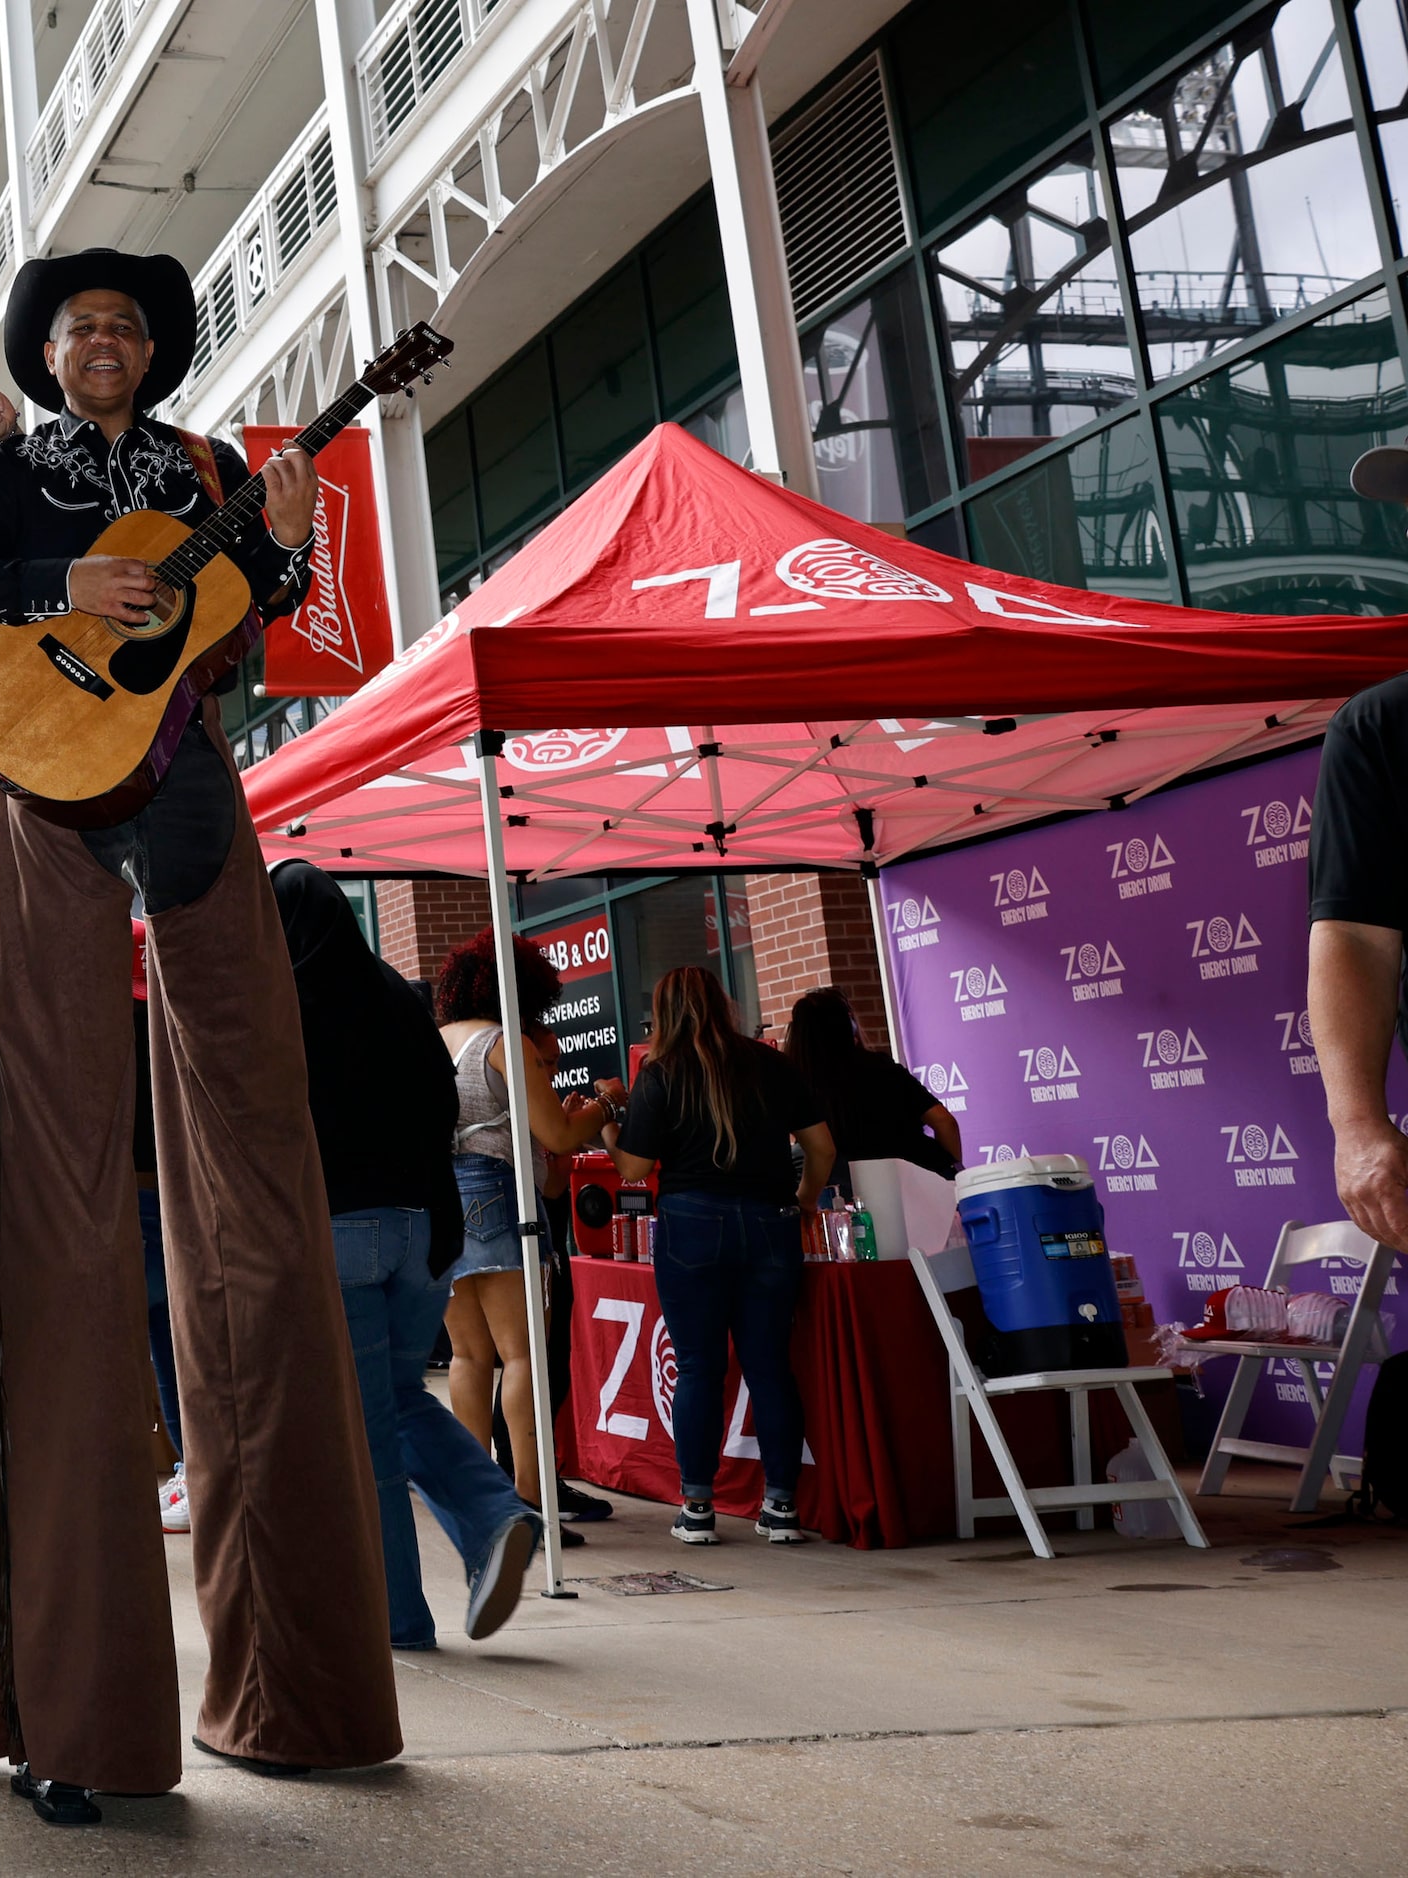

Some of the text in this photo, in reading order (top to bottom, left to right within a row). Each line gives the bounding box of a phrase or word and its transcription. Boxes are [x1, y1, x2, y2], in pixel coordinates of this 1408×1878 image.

[1255, 843, 1289, 868] ENERGY
[1118, 872, 1173, 900] ENERGY DRINK
[1001, 902, 1048, 926] ENERGY DRINK
[571, 943, 583, 968] &
[583, 927, 609, 963] GO
[897, 928, 939, 952] ENERGY DRINK
[1199, 953, 1258, 980] ENERGY DRINK
[1072, 978, 1123, 1002] ENERGY DRINK
[960, 999, 1006, 1022] ENERGY DRINK
[557, 1026, 617, 1054] NDWICHES
[1289, 1055, 1321, 1075] ENERG
[552, 1067, 590, 1089] NACKS
[1150, 1067, 1205, 1090] ENERGY DRINK
[1030, 1082, 1080, 1103] ENERGY DRINK
[1106, 1174, 1158, 1192] ENERGY DRINK
[1234, 1166, 1296, 1187] ENERGY DRINK
[1186, 1274, 1215, 1291] ENERGY
